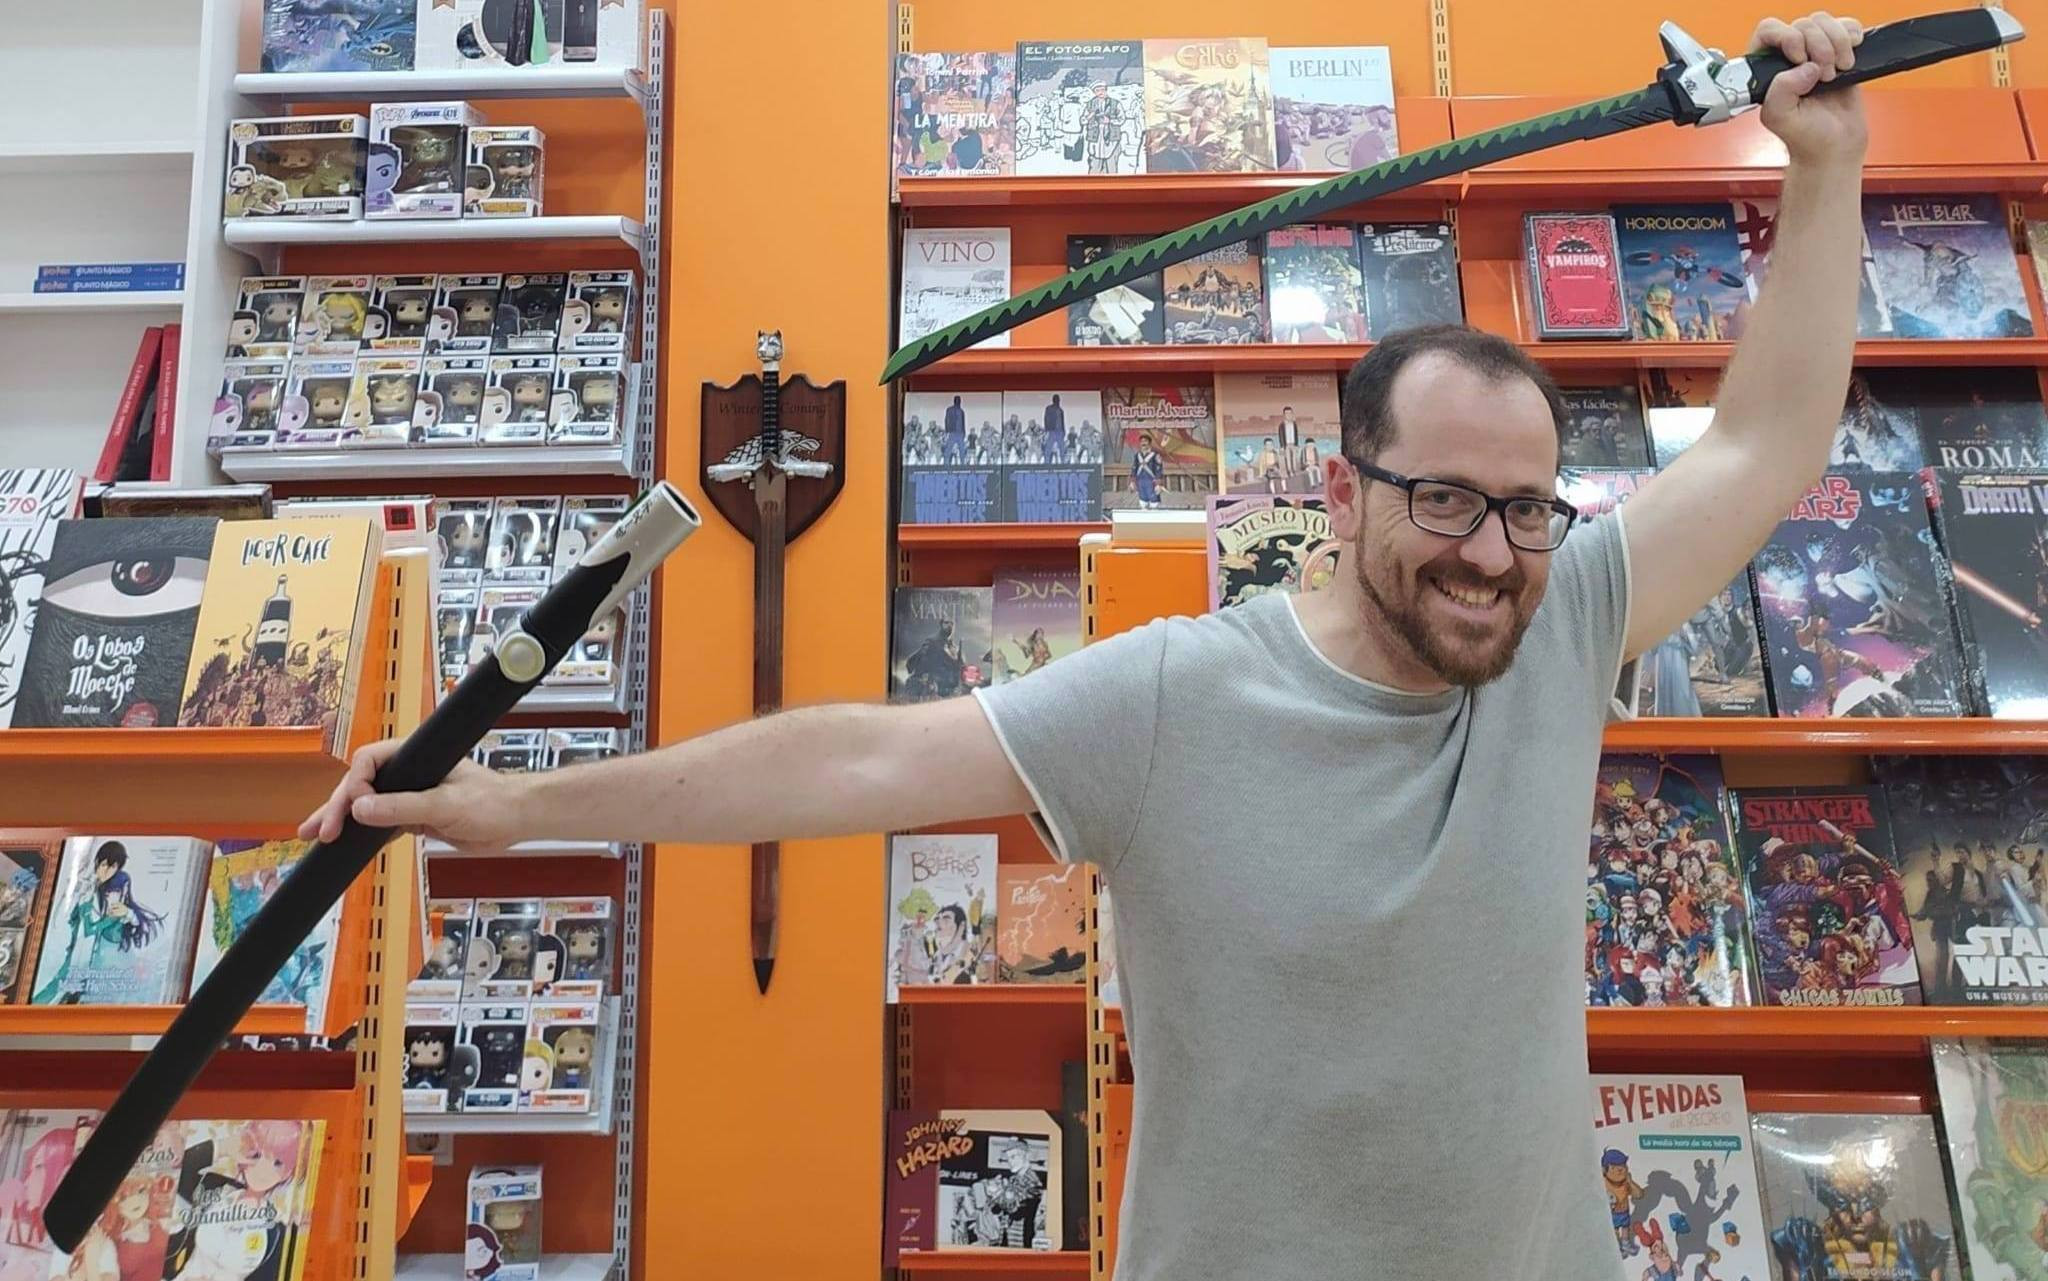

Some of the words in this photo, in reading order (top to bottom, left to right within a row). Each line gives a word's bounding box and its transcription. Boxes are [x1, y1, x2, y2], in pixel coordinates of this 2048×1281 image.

[1025, 46, 1042, 55] EL
[1046, 44, 1130, 54] FOTÓGRAFO
[1289, 59, 1362, 78] BERLIN
[915, 114, 931, 128] LA
[937, 113, 998, 129] MENTIRA
[1625, 217, 1726, 232] HOROLOGIOM
[918, 242, 995, 262] VINO
[1546, 254, 1608, 268] VAMPIROS
[1785, 498, 1862, 521] ARS
[1959, 485, 2034, 515] DARTH
[1233, 510, 1296, 541] MUSEO
[291, 534, 332, 562] CAFÉ
[95, 634, 145, 670] Lobos
[67, 666, 135, 713] Moeche
[1743, 797, 1875, 829] STRANGER
[1966, 992, 1989, 1001] UNA
[1992, 992, 2029, 1001] NUEVA
[1594, 1083, 1722, 1129] EYENDAS
[904, 1118, 966, 1146] JOHNNY
[897, 1136, 974, 1178] HAZARD
